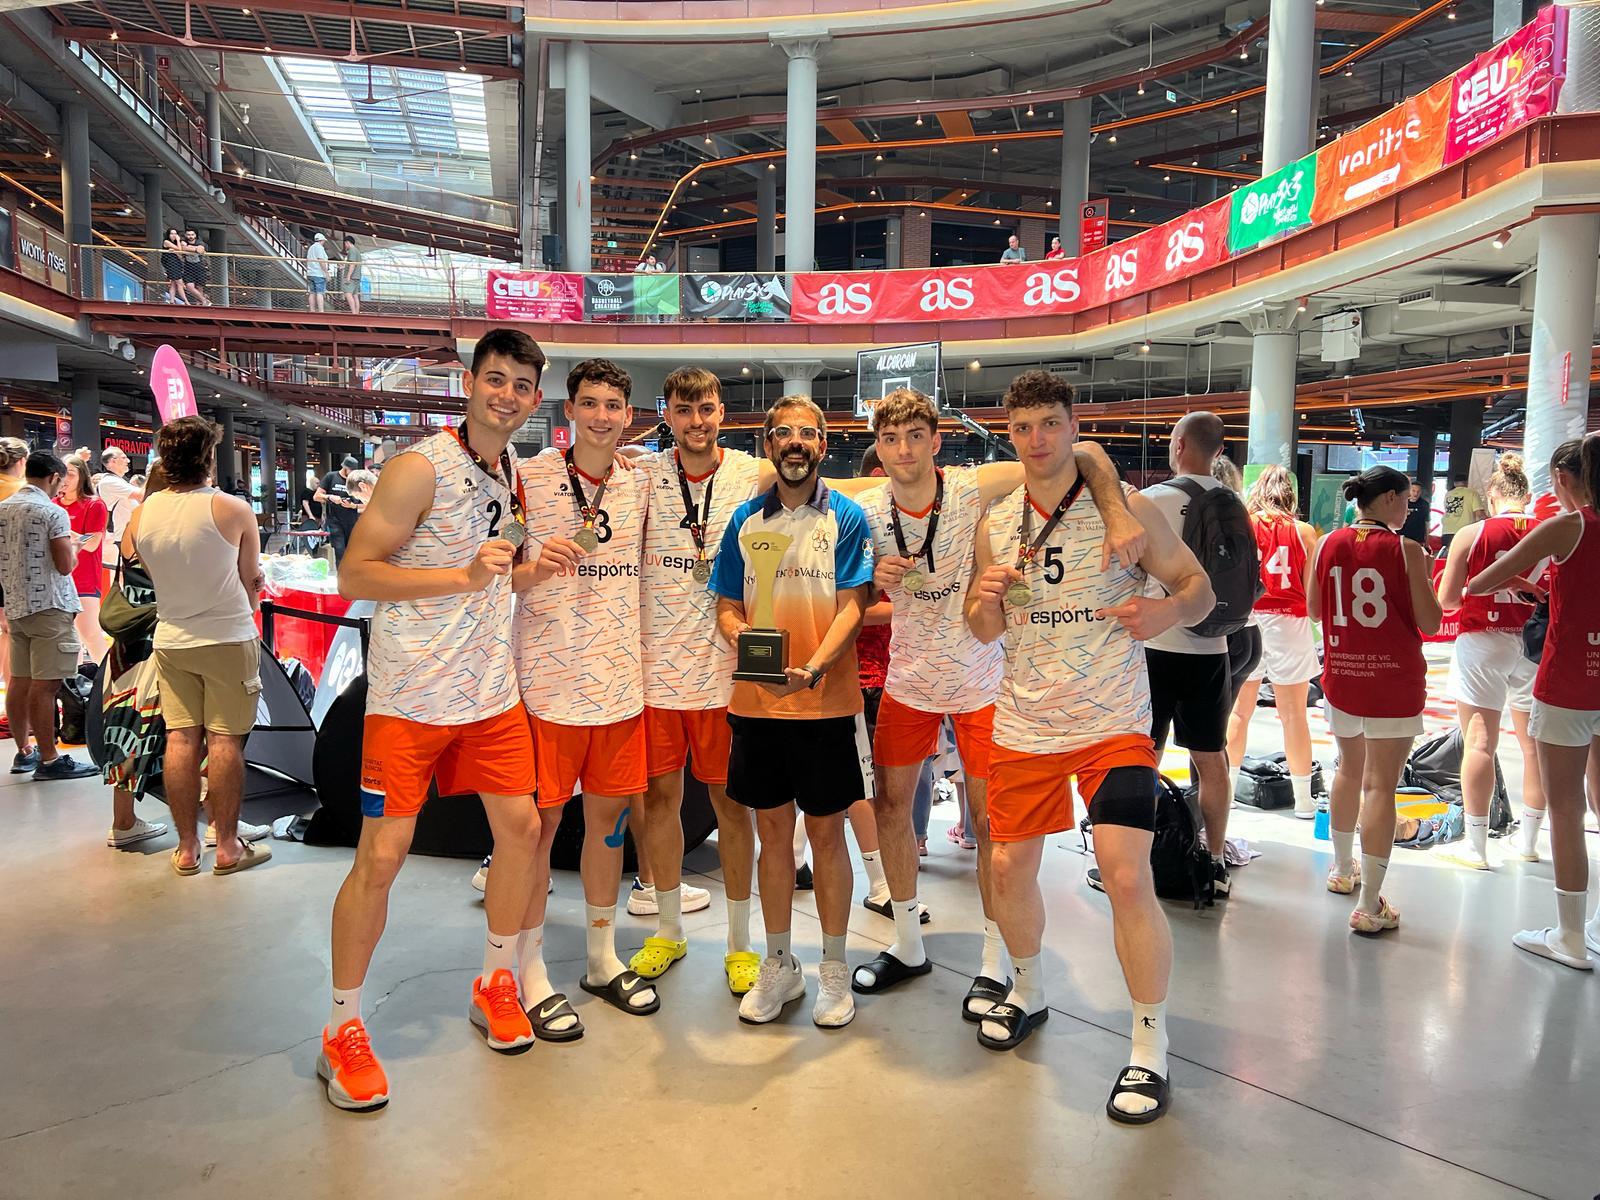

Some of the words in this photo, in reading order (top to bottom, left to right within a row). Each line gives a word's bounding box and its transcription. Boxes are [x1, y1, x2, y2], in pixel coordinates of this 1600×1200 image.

[1165, 221, 1205, 271] as
[1104, 247, 1138, 292] as
[817, 282, 872, 315] as
[919, 277, 974, 312] as
[1023, 269, 1081, 306] as
[486, 500, 502, 538] 2
[594, 508, 613, 544] 3
[679, 503, 702, 529] 4
[1043, 547, 1065, 585] 5
[1329, 566, 1388, 628] 18
[1329, 635, 1340, 647] U
[1588, 632, 1600, 645] U
[1330, 652, 1365, 661] UNIVERSITAT
[1330, 660, 1365, 669] UNIVERSITAT
[1331, 667, 1340, 675] DE
[1340, 668, 1375, 677] CATALUNYA
[1586, 669, 1599, 677] DE
[1125, 1069, 1151, 1082] NIKE
